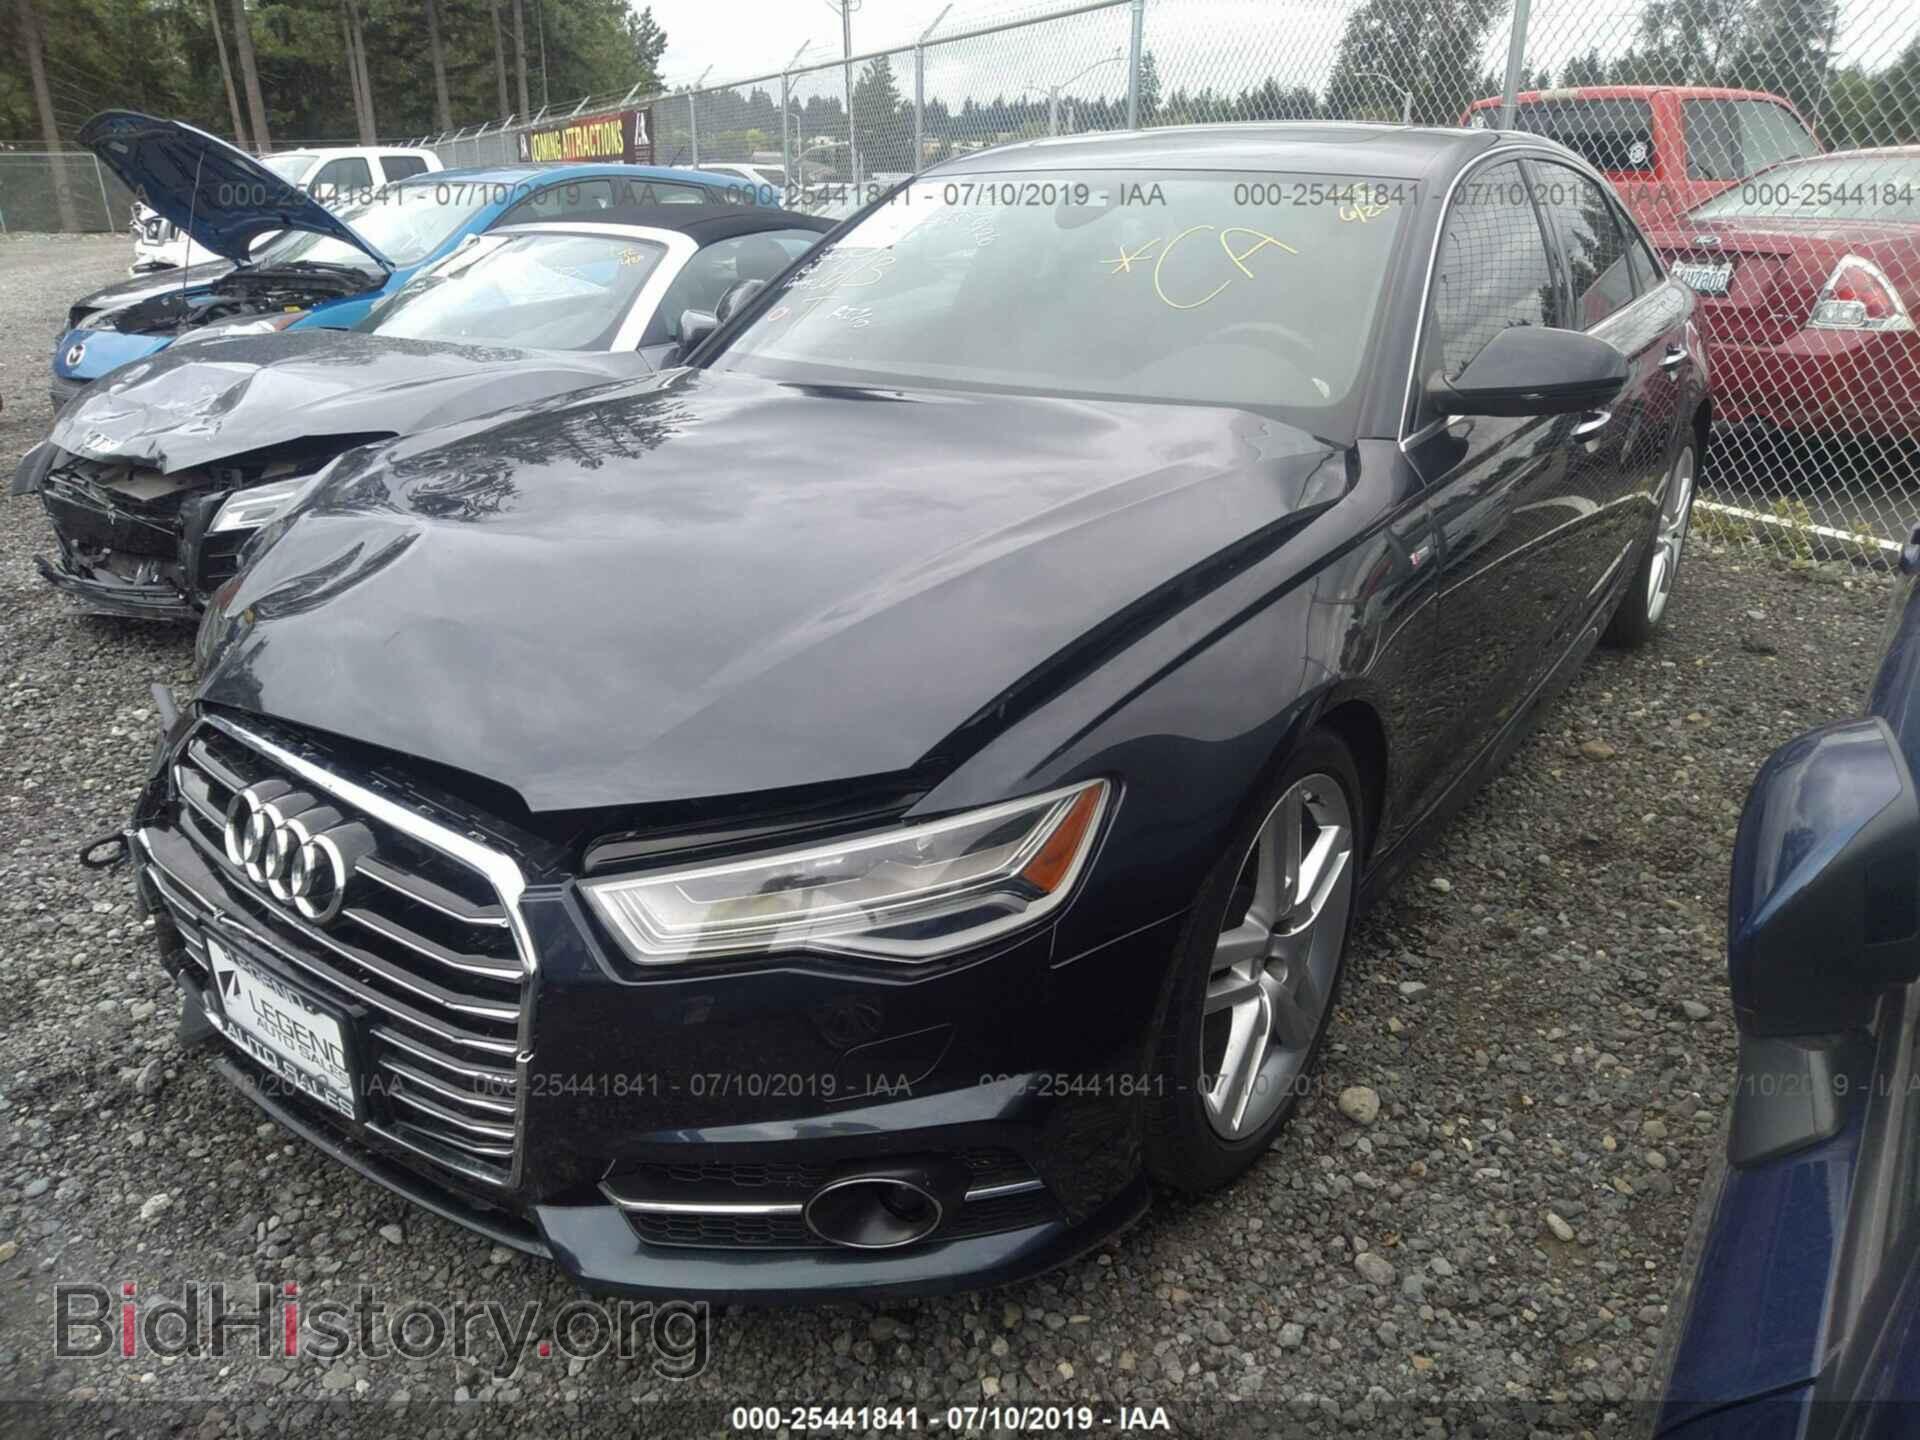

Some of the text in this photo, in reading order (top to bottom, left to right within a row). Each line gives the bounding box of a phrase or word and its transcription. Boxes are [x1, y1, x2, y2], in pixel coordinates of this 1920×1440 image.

[562, 119, 624, 160] ATTRACTIONS
[226, 1022, 279, 1071] AUTO
[256, 1016, 296, 1051] AUTO
